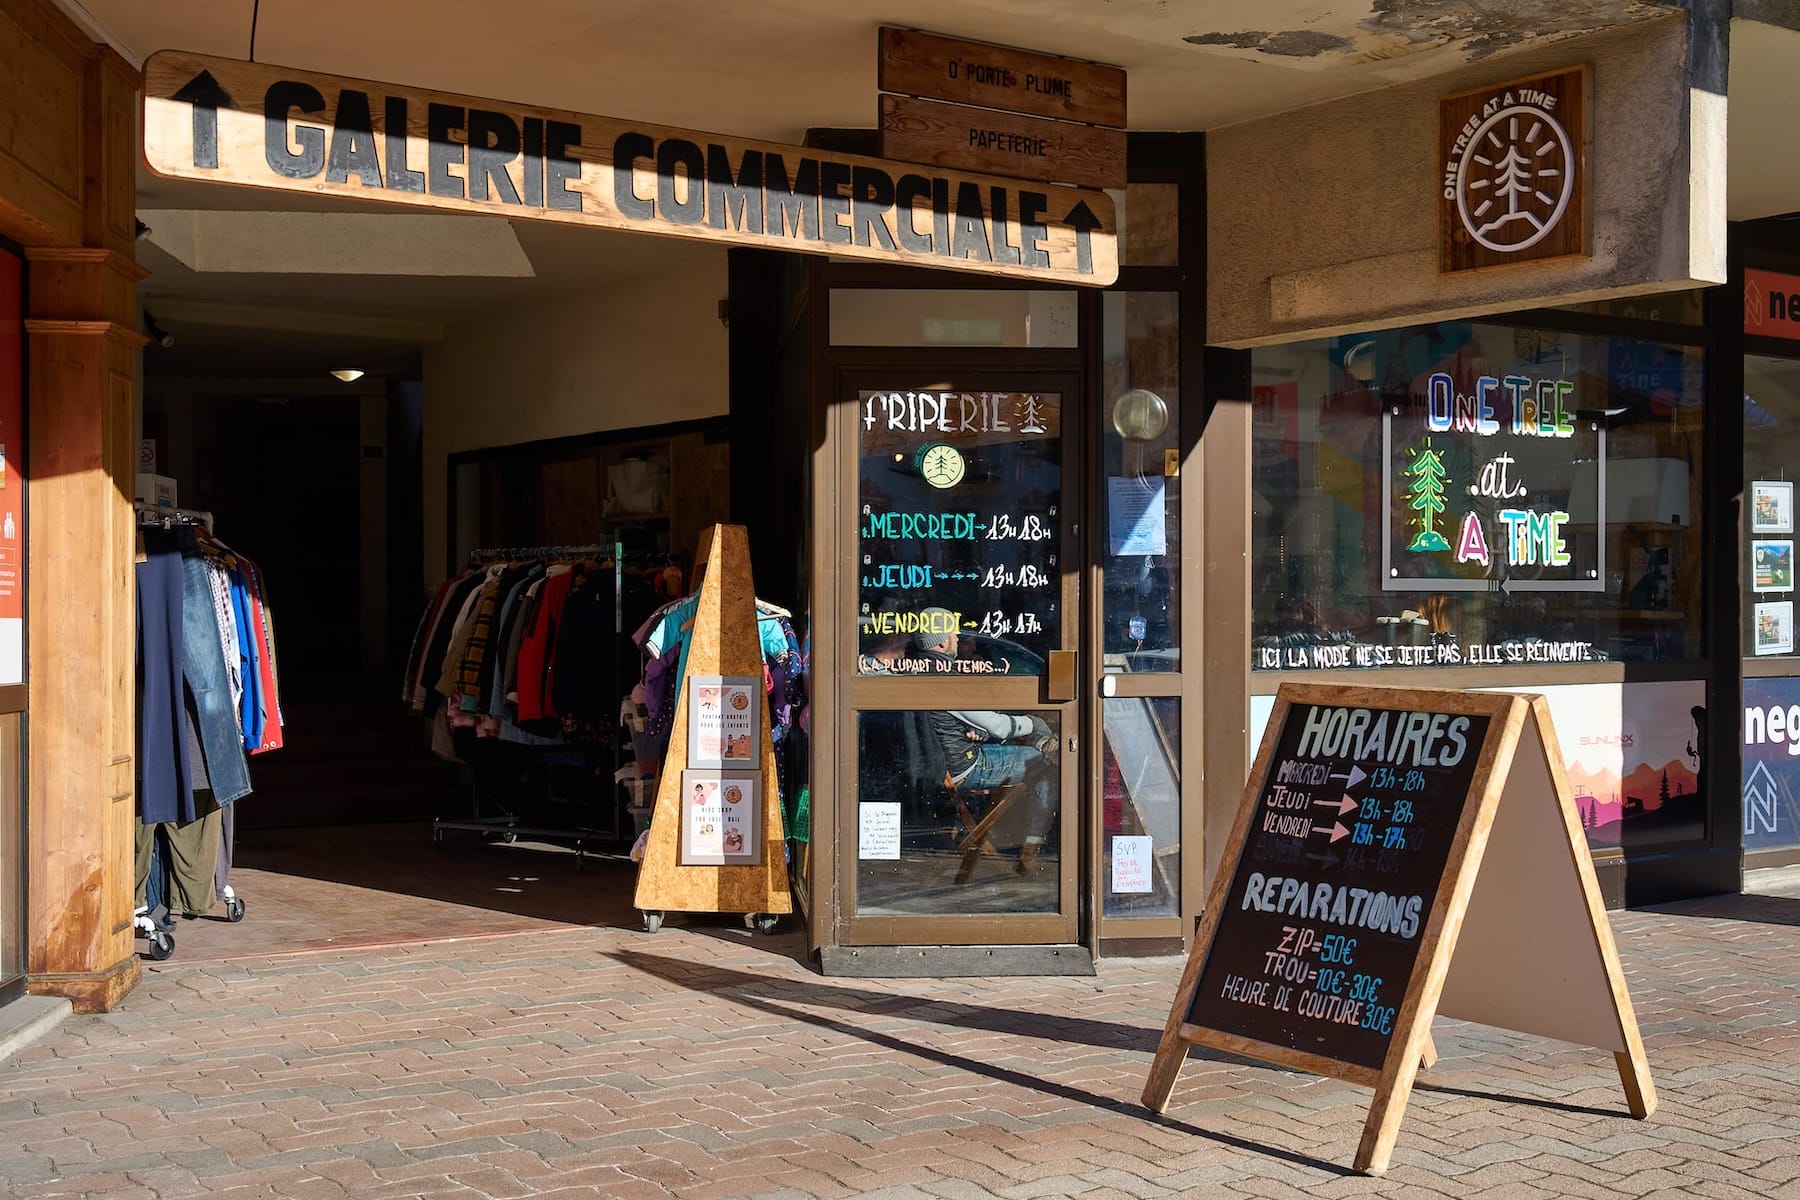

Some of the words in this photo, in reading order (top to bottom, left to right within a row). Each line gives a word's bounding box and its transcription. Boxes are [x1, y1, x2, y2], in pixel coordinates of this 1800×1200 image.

[967, 64, 1010, 88] PORTE
[1026, 74, 1072, 97] PLUME
[264, 81, 583, 212] GALERIE
[613, 132, 1050, 268] COMMERCIALE
[1443, 161, 1458, 200] ONE
[1451, 113, 1482, 155] TREE
[1482, 96, 1500, 118] AT
[1502, 91, 1514, 107] A
[1519, 89, 1557, 110] TIME
[1426, 372, 1500, 435] ONE
[1504, 374, 1574, 437] TREE
[1457, 510, 1489, 567] A
[884, 656, 931, 674] PLUPART
[936, 658, 952, 673] DU
[1261, 646, 1281, 668] ICI
[1288, 647, 1309, 668] LA
[1313, 646, 1351, 670] MODE
[1356, 646, 1373, 667] NE
[1375, 645, 1394, 665] SE
[1469, 643, 1504, 664] ELLE
[1506, 642, 1523, 661] SE
[1296, 705, 1471, 767] HORAIRES
[1241, 871, 1424, 940] REPARATIONS
[1220, 973, 1271, 1007] HEURE
[1273, 984, 1293, 1012] DE
[1297, 989, 1365, 1026] COUTURE
[1360, 1002, 1396, 1036] 30€
